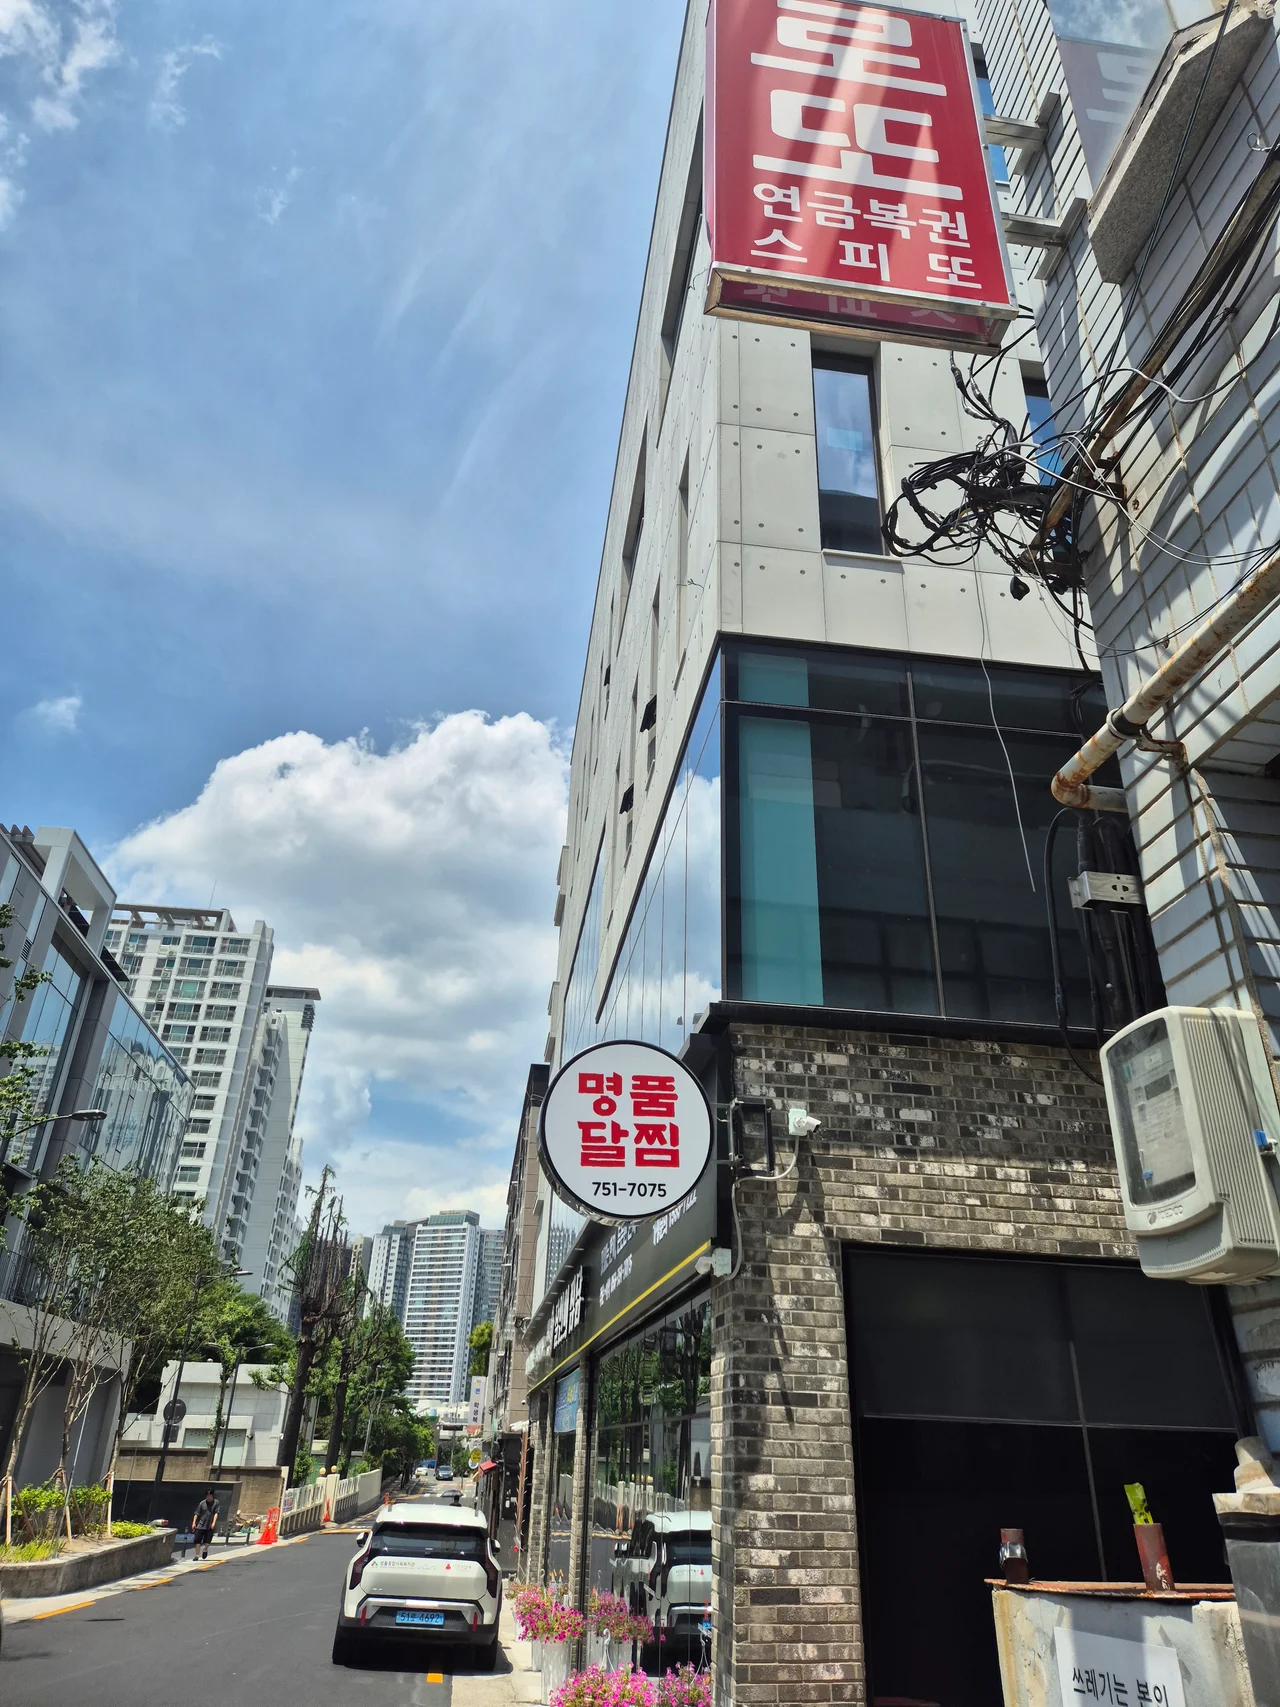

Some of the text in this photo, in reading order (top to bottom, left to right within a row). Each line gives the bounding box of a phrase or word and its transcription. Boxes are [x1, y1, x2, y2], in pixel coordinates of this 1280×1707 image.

[751, 0, 964, 201] 로또
[752, 182, 971, 249] 연금복권
[577, 1071, 679, 1118] 명품
[577, 1119, 681, 1169] 달찜
[592, 1181, 668, 1199] 751-7075
[419, 1612, 440, 1624] 4692
[1071, 1667, 1129, 1707] 쓰레기는
